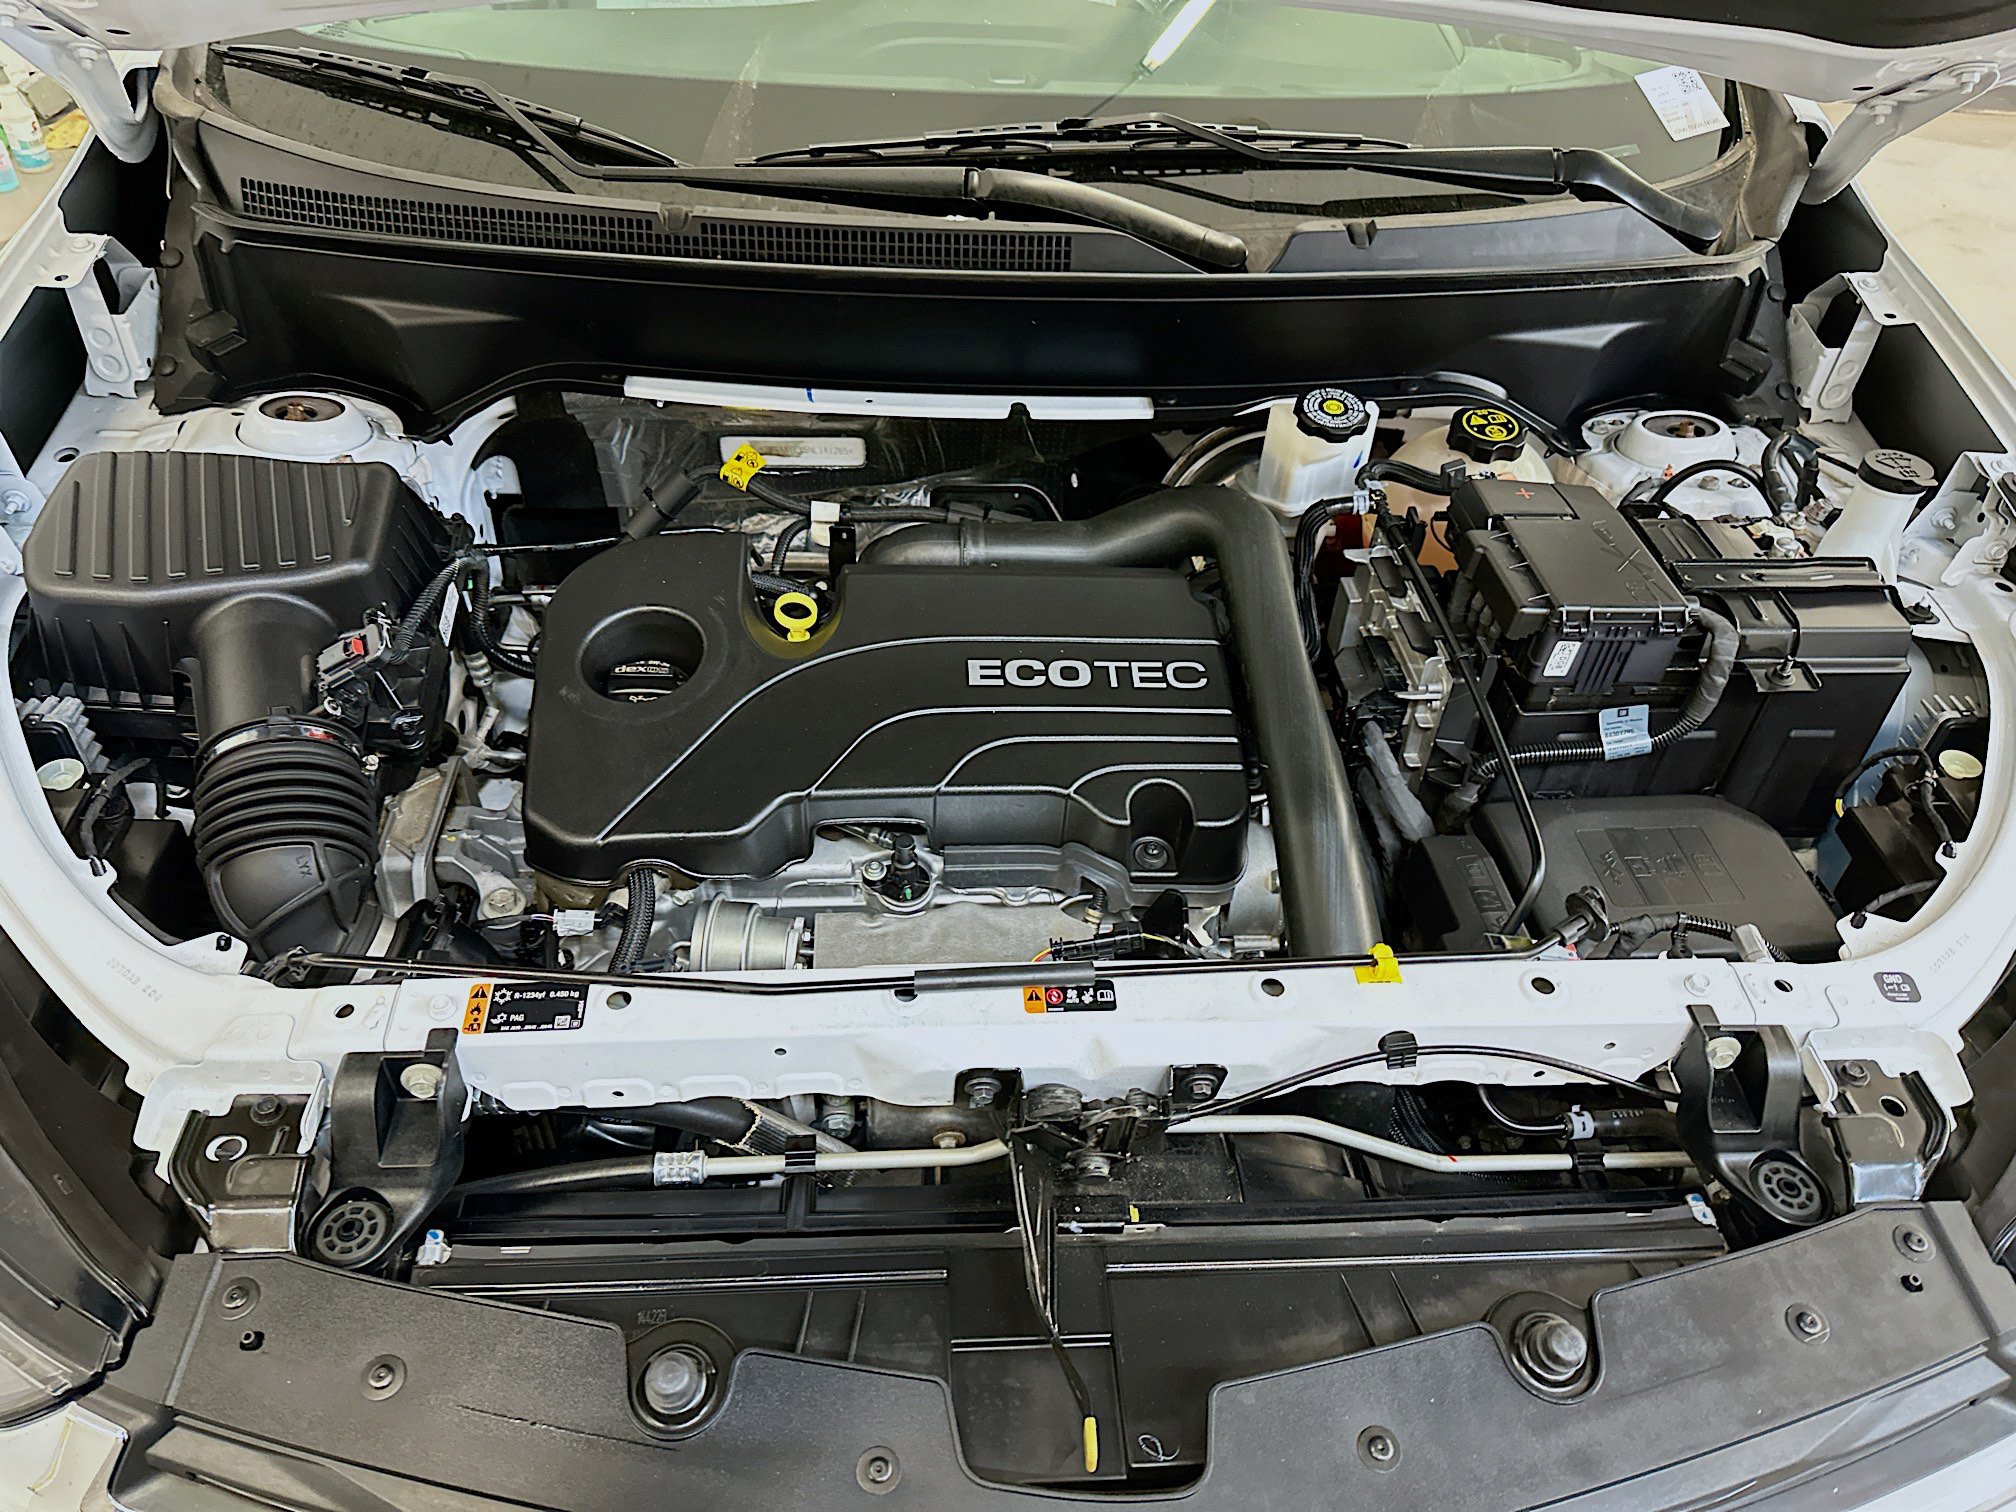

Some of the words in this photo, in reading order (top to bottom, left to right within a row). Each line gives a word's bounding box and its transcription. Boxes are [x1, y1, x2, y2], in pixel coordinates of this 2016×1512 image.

[614, 665, 669, 674] dexos
[967, 659, 1207, 688] ECOTEC
[513, 990, 546, 1000] R-1234yf
[549, 990, 569, 998] 0.450
[570, 990, 580, 998] kg
[509, 1014, 525, 1022] PAG
